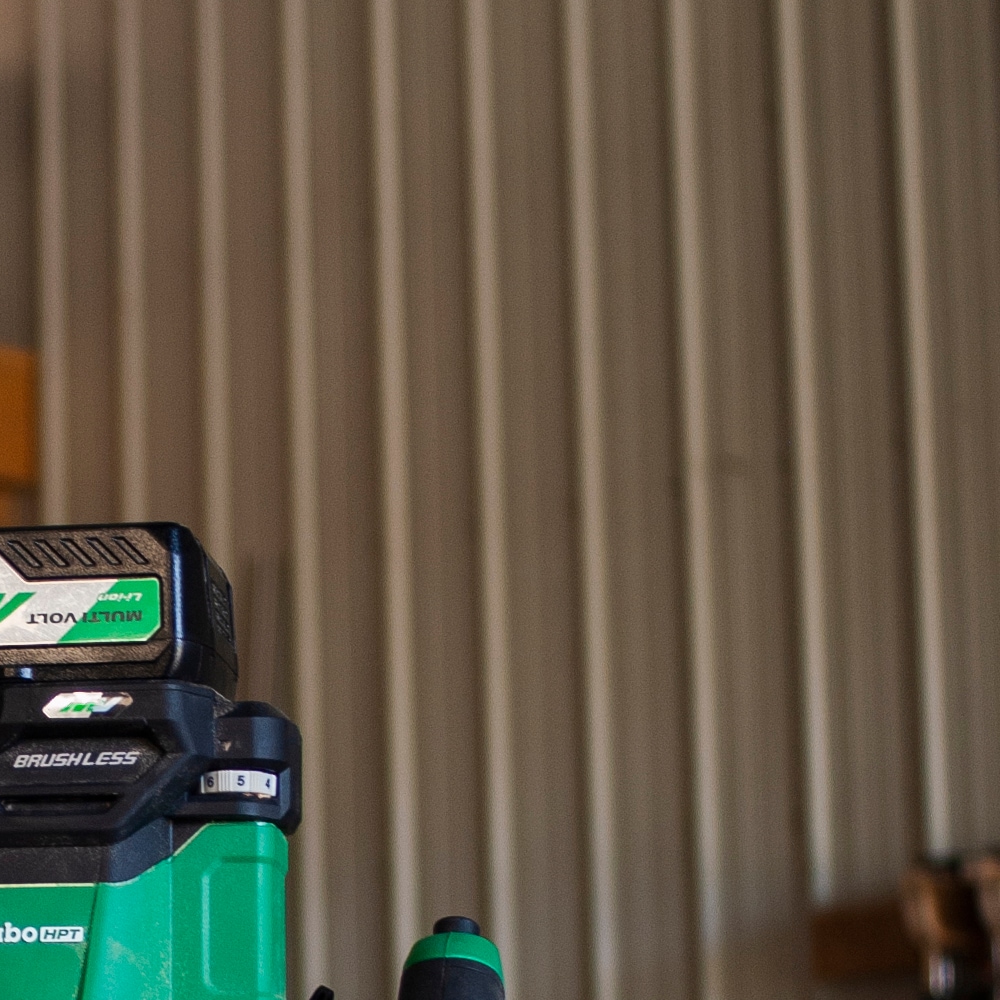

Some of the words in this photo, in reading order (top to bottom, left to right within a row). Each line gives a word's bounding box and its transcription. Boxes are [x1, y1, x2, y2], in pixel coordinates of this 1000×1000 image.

[26, 612, 79, 625] VOLT
[82, 610, 143, 623] MULTI
[13, 751, 140, 769] BRUSHLESS
[206, 776, 215, 788] 6
[236, 775, 246, 786] 5
[265, 778, 271, 789] 4
[43, 928, 81, 940] HPT
